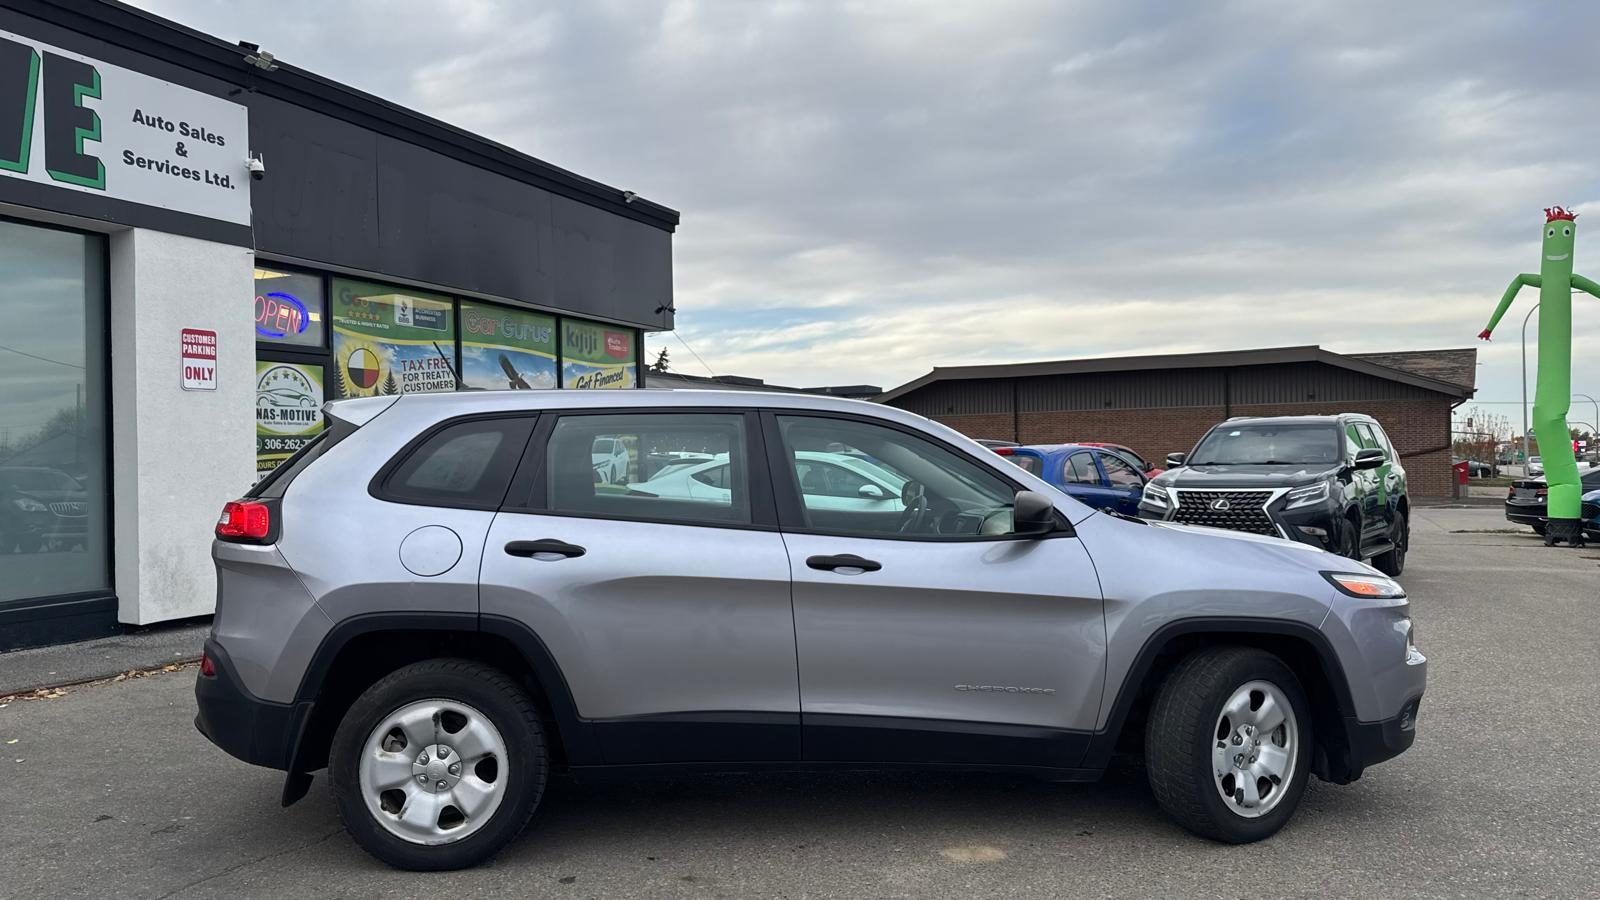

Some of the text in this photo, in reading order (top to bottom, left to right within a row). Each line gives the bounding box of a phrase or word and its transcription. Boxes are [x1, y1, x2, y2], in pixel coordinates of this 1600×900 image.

[132, 109, 225, 147] Auto Sales
[175, 142, 188, 158] &
[123, 150, 235, 189] Services Ltd.
[255, 296, 300, 333] OPEN
[183, 334, 215, 345] CUSTOMER
[183, 344, 215, 356] PARKING
[401, 360, 424, 371] TAX
[185, 366, 213, 381] ONLY
[403, 370, 450, 382] FOR TREATY
[404, 380, 454, 392] CUSTOMERS
[256, 408, 317, 421] NAS-MOTIVE
